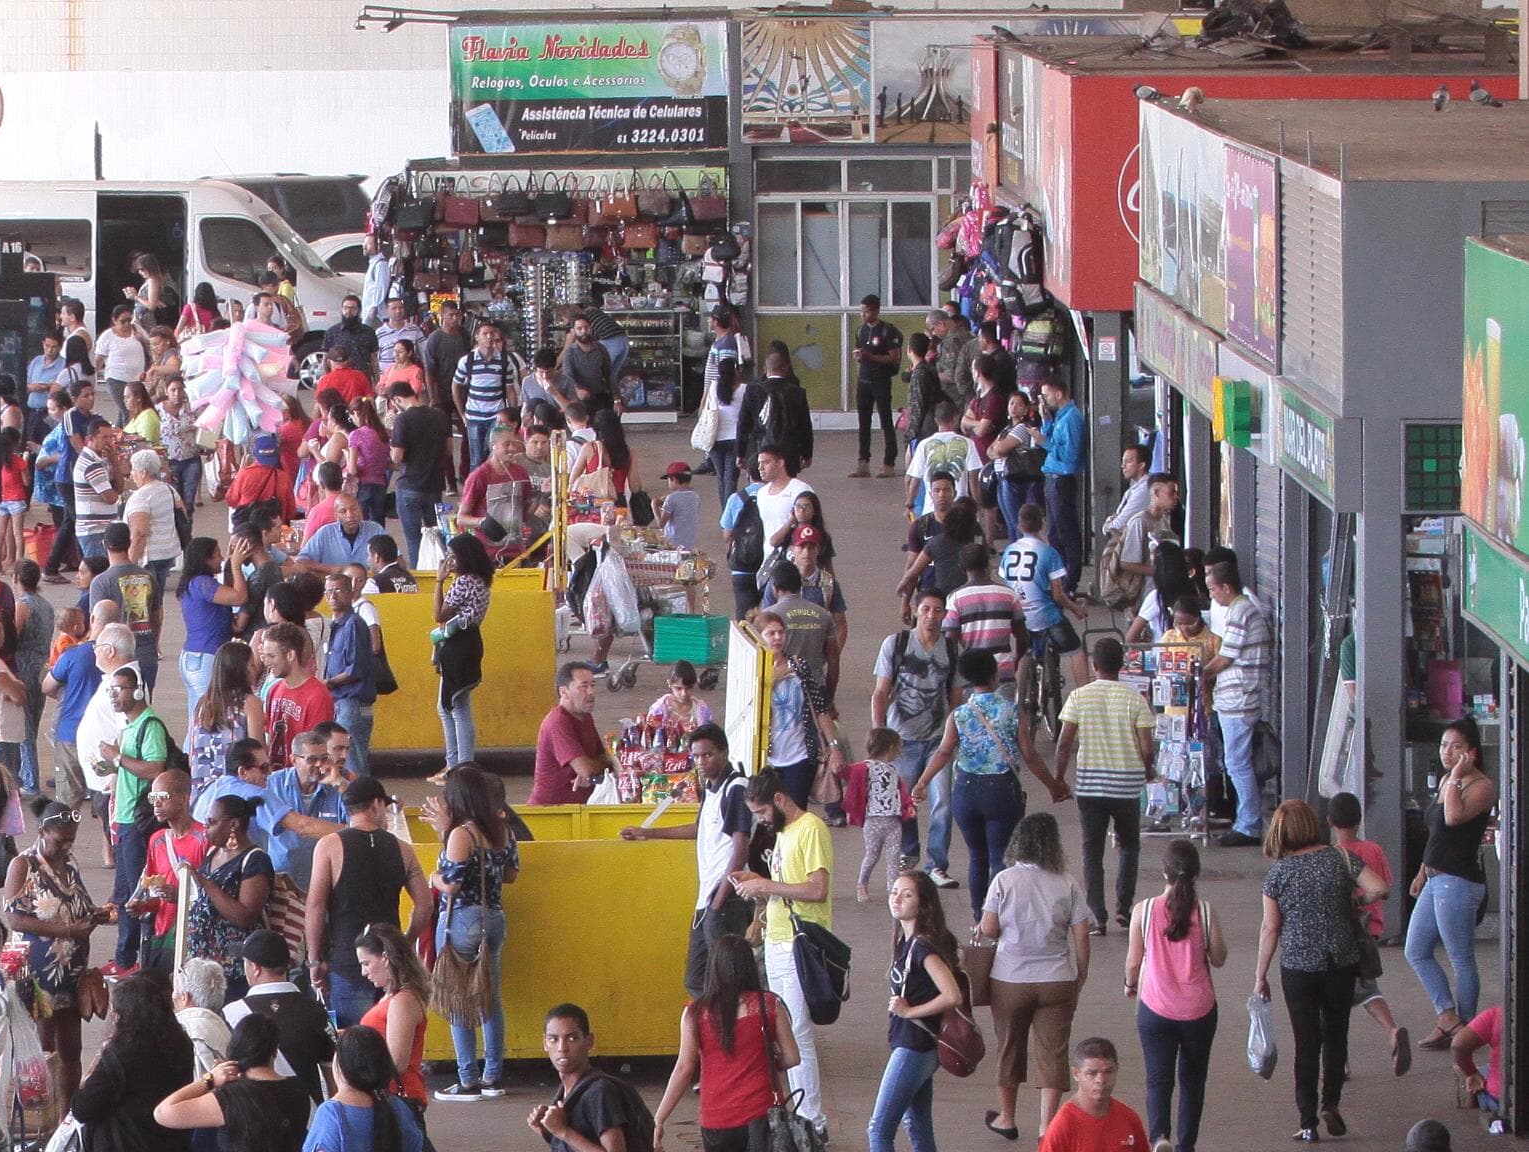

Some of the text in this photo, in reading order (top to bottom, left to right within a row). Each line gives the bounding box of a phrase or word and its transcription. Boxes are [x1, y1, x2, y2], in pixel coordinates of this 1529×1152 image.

[538, 34, 651, 61] Novidades
[521, 104, 702, 121] Assistência Técnica de Celulares
[617, 128, 705, 144] 61 3224.0301
[2, 242, 22, 253] A 16
[1006, 551, 1038, 581] 23
